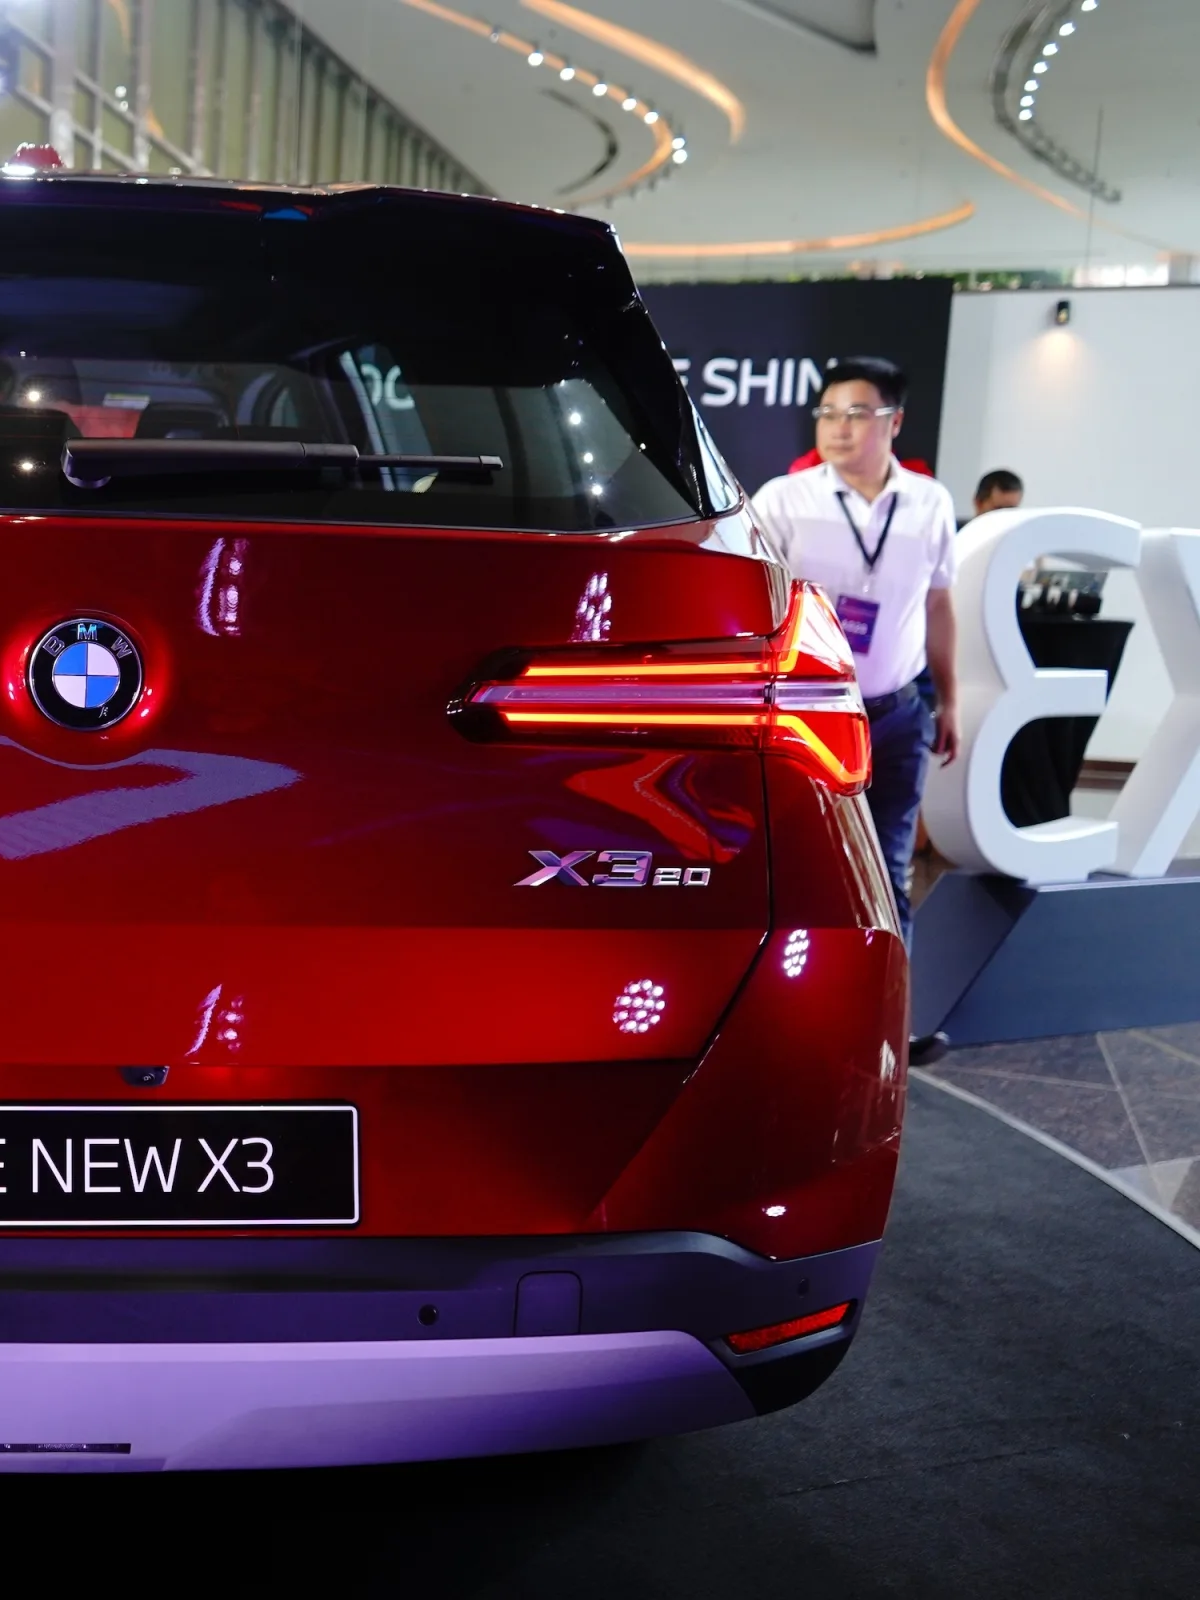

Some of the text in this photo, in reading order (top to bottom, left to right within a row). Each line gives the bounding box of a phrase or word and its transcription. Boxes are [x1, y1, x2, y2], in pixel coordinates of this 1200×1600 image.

[42, 623, 133, 660] BMW
[32, 1137, 182, 1194] NEW
[197, 1137, 274, 1194] X3
